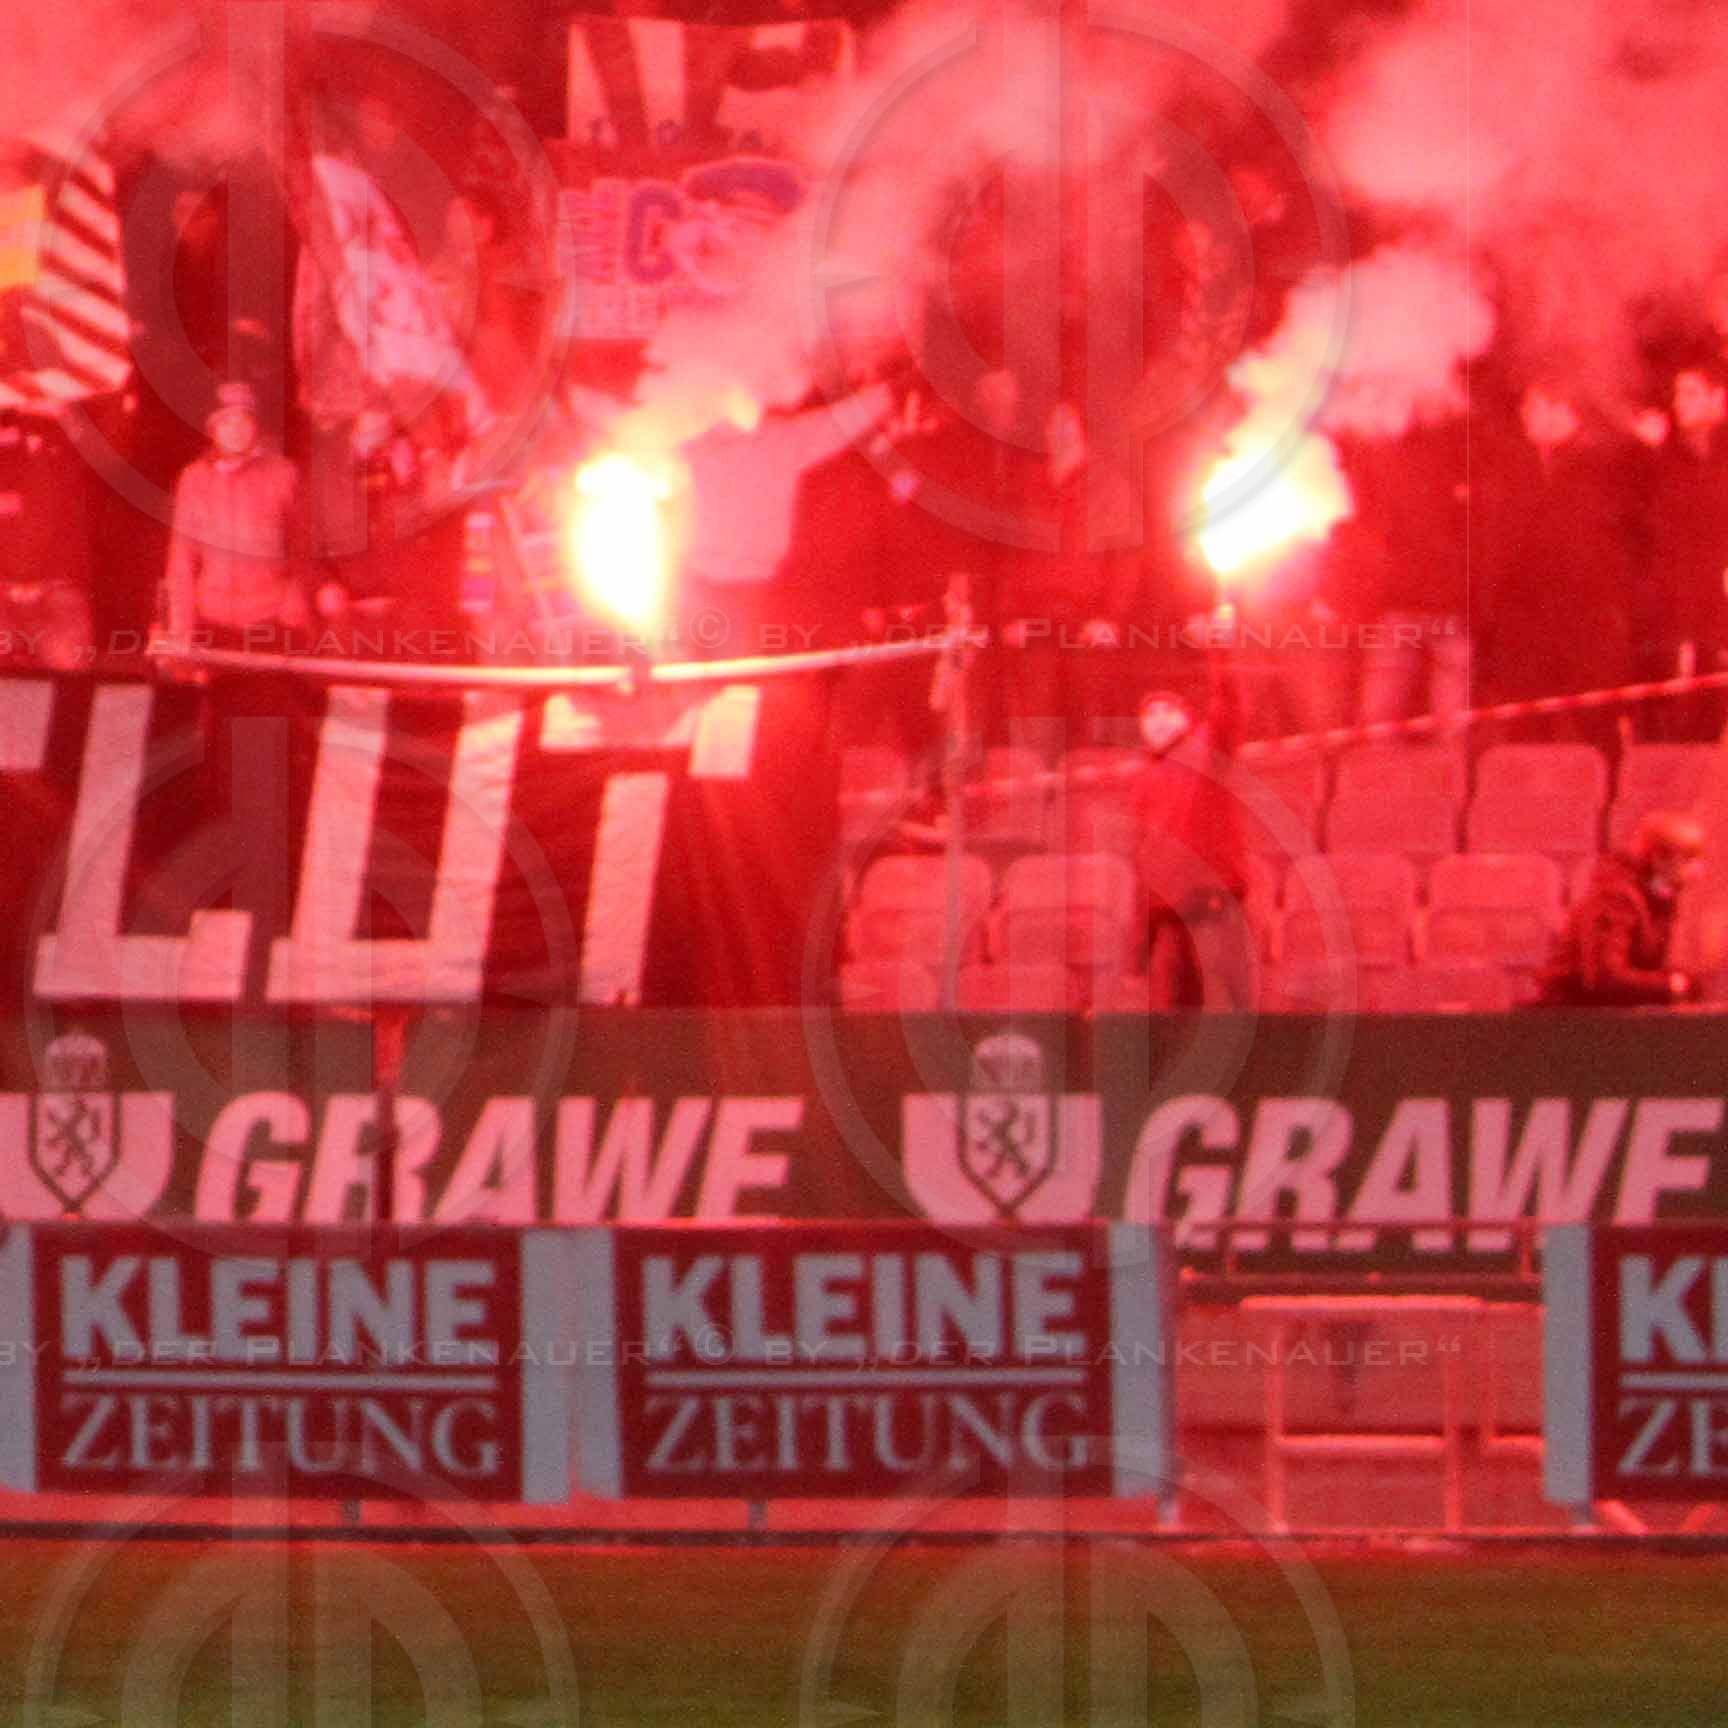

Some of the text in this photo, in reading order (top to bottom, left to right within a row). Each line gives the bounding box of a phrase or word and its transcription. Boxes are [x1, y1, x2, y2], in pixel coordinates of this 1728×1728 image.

[193, 1091, 805, 1223] GRAWE
[1124, 1093, 1725, 1253] GRAWE
[59, 1253, 498, 1366] KLEINE
[644, 1250, 1088, 1363] KLEINE
[1619, 1255, 1728, 1365] K
[59, 1393, 498, 1473] ZEITUNG
[644, 1388, 1092, 1472] ZEITUNG
